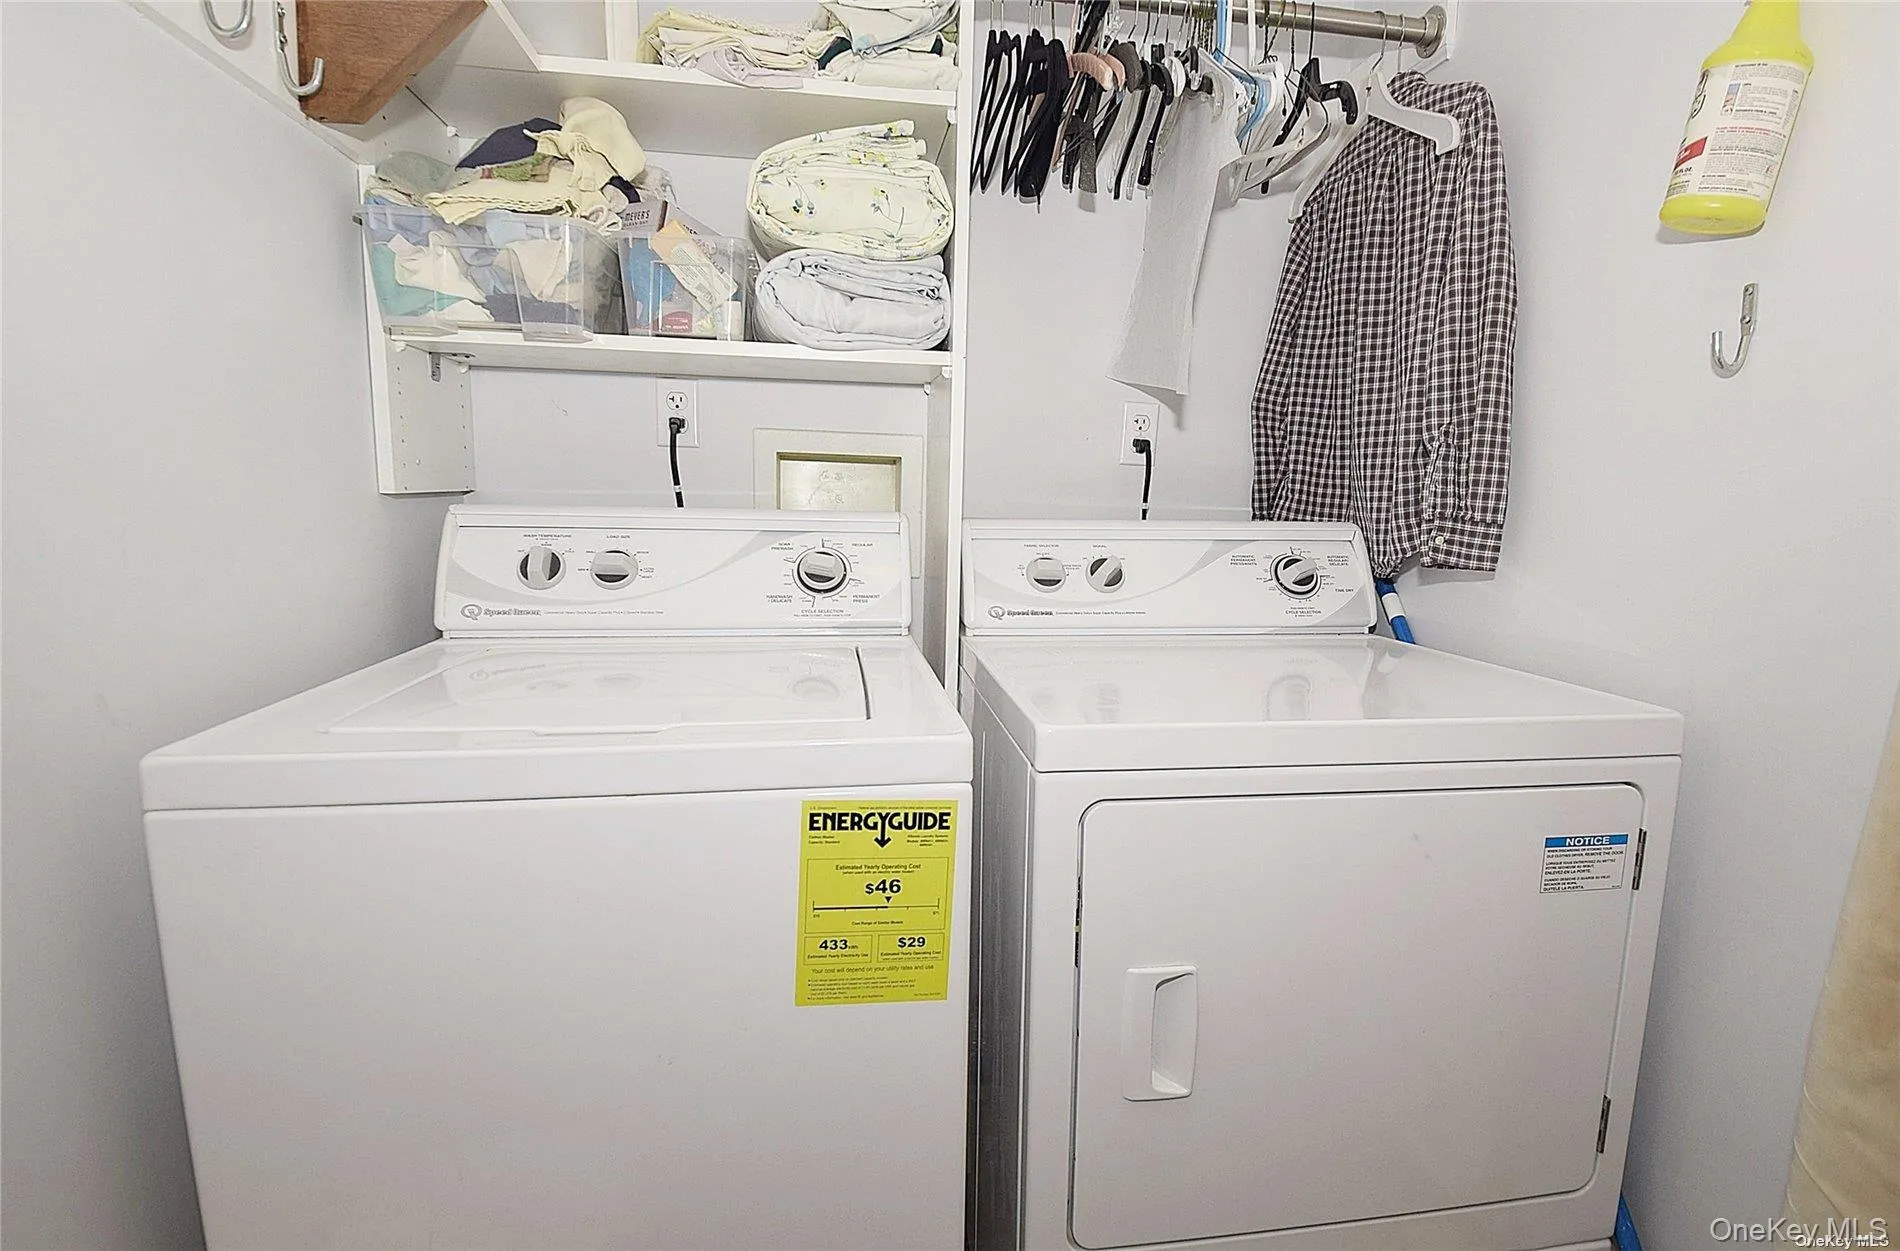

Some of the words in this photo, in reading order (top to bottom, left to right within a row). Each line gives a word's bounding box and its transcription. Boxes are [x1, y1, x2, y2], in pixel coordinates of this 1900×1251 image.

[809, 811, 951, 833] ENERGYGUIDE
[1566, 836, 1610, 846] NOTICE
[881, 863, 908, 871] Operating
[865, 879, 901, 894] $46
[819, 939, 848, 950] 433
[897, 937, 926, 949] $29
